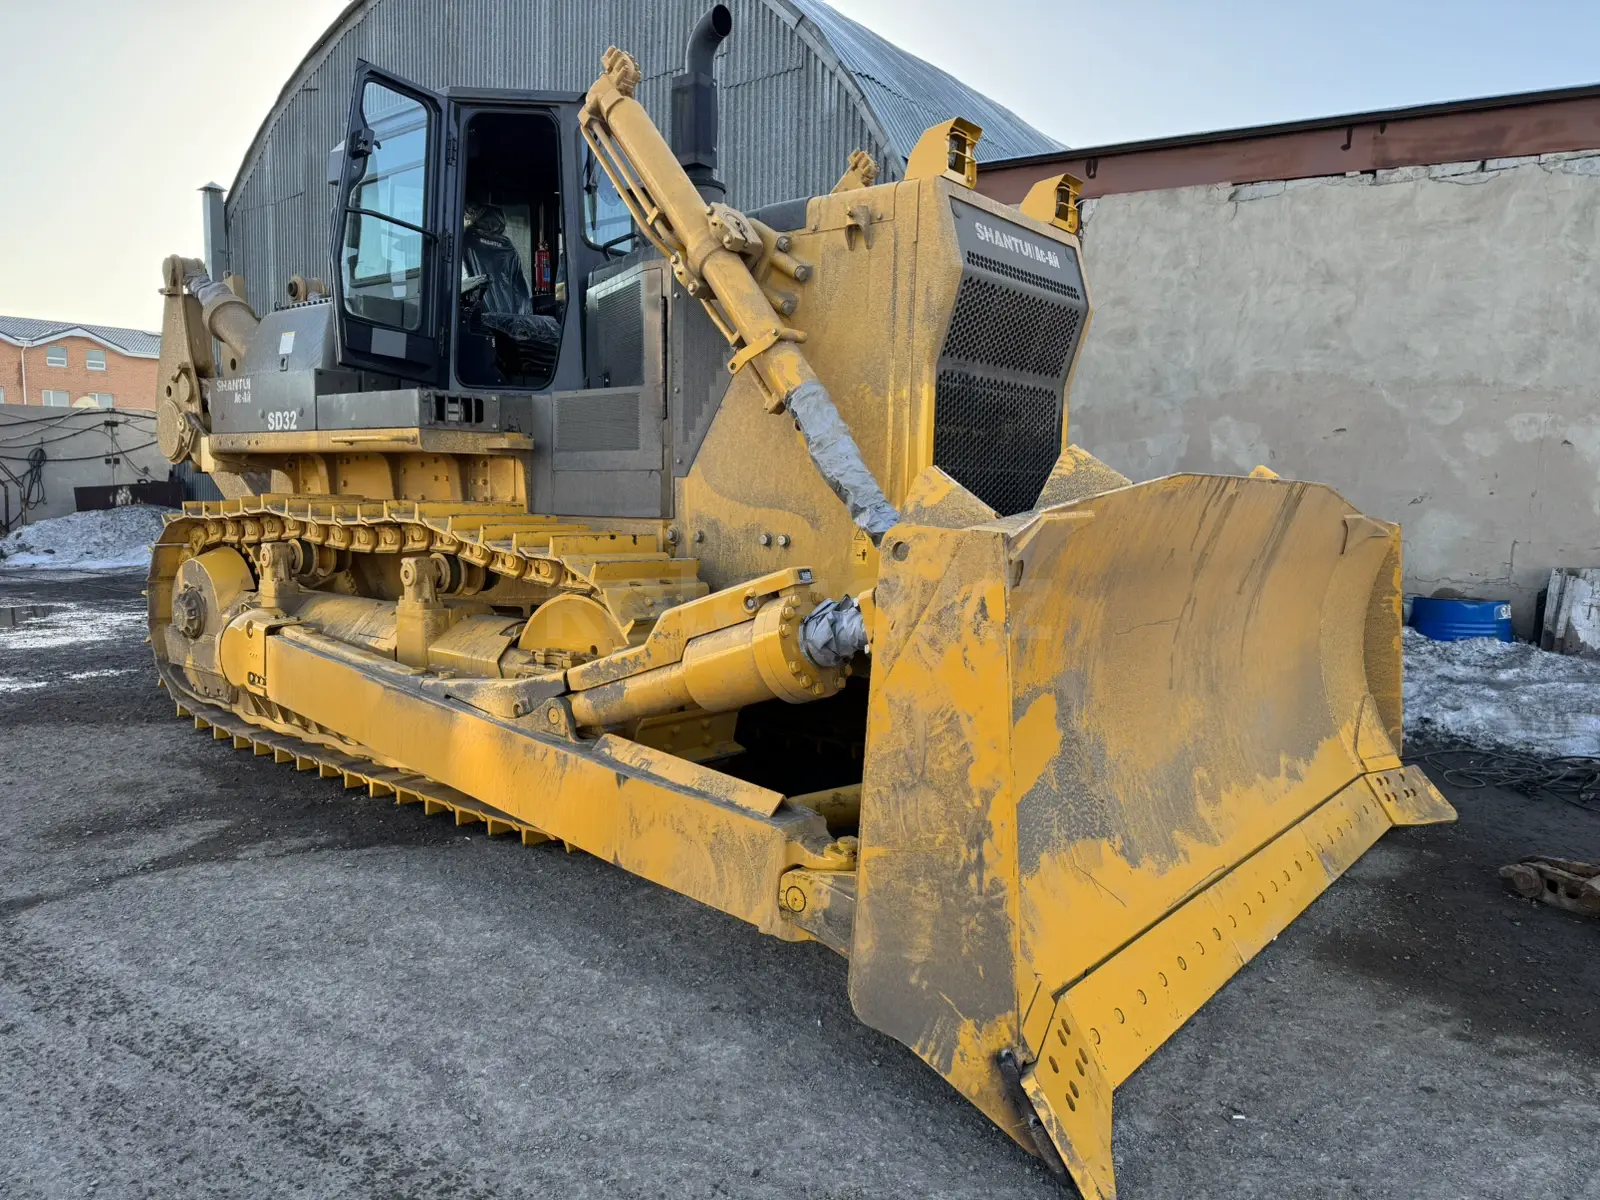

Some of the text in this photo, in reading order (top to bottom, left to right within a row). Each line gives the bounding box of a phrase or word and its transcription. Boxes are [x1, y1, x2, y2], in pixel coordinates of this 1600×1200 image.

[974, 222, 1033, 259] SHANTUI
[216, 378, 251, 392] SHANTUI
[267, 410, 297, 430] SD32
